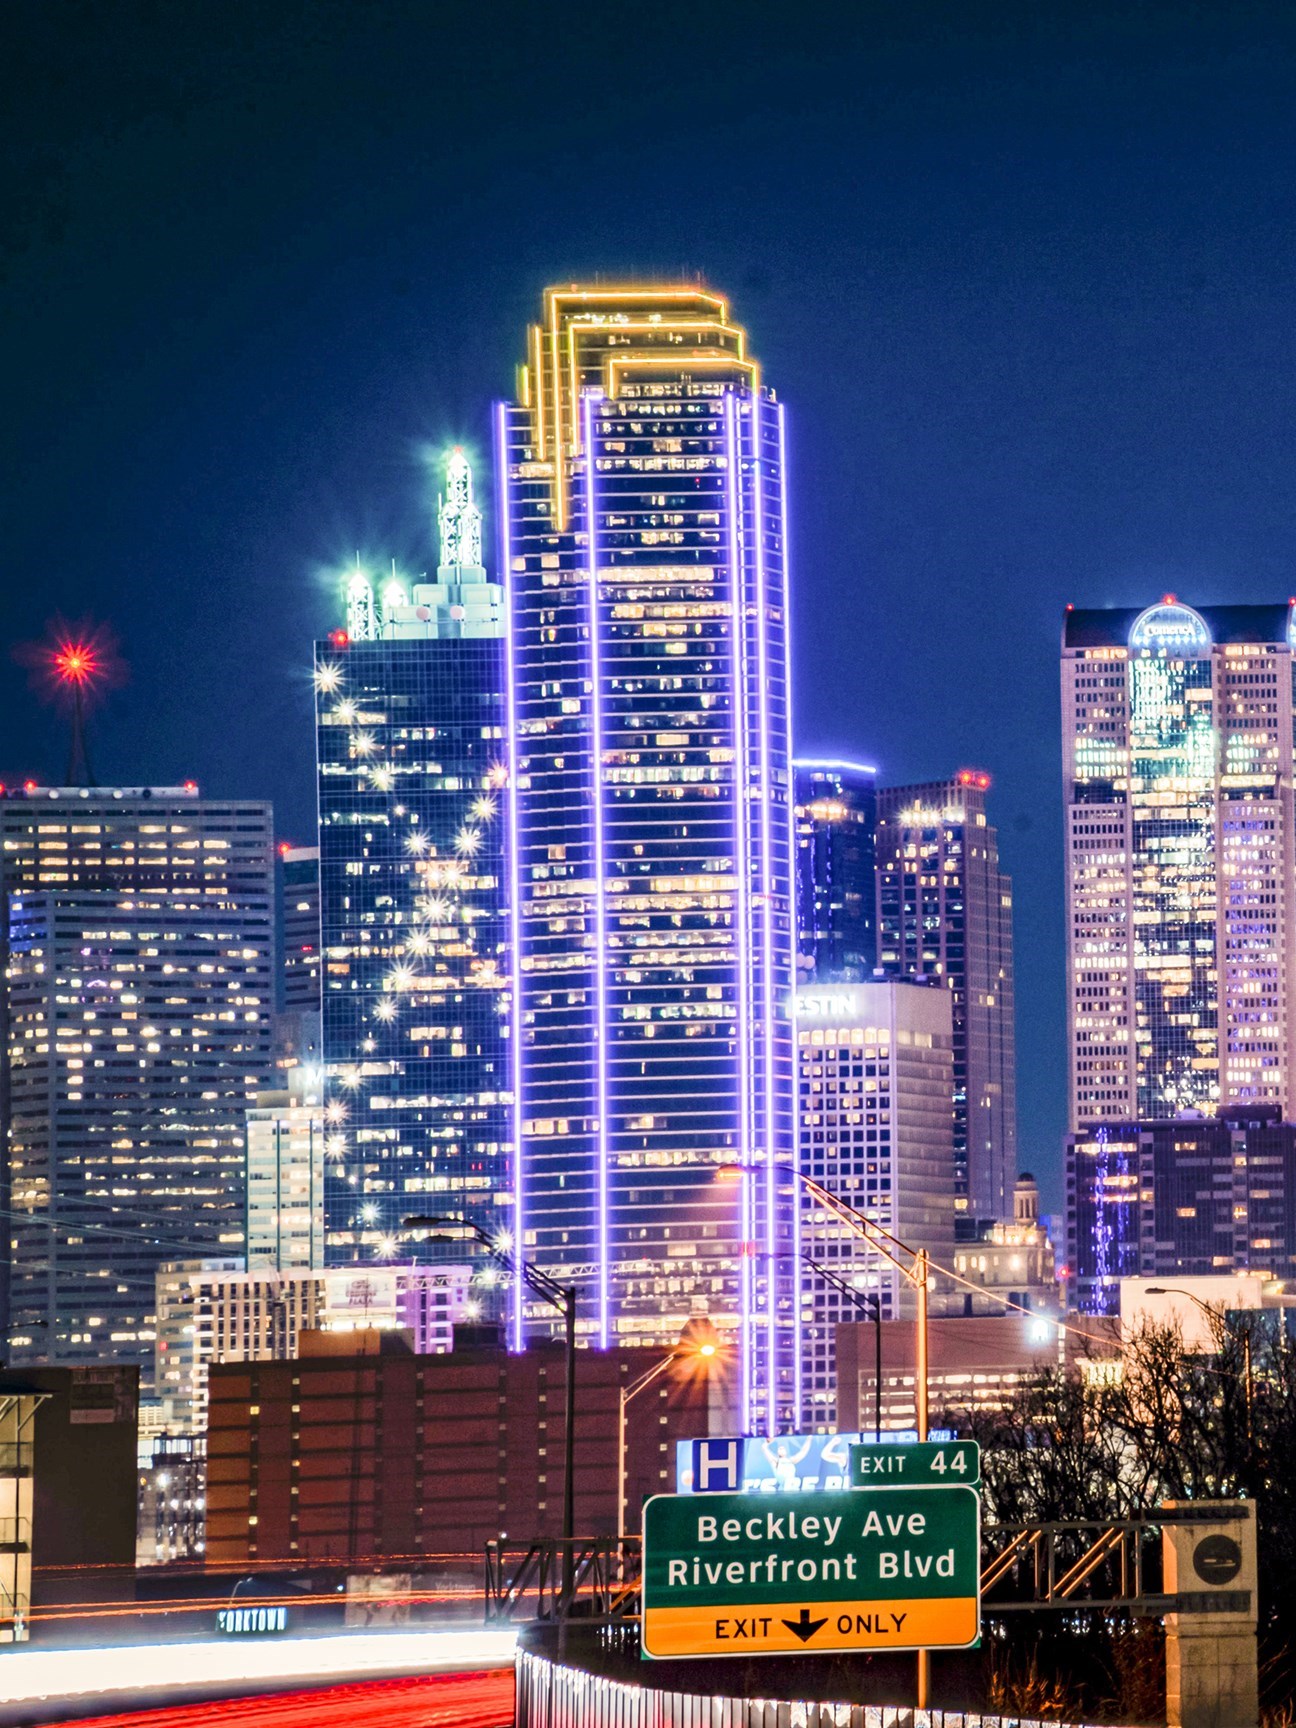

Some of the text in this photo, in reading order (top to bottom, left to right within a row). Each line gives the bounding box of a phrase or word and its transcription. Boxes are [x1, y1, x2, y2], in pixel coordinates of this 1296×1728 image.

[793, 995, 857, 1016] ESTIN
[700, 1441, 737, 1489] H
[860, 1450, 968, 1475] EXIT 44
[697, 1510, 927, 1546] Beckley Ave
[668, 1549, 956, 1586] Riverfront Blvd
[219, 1607, 287, 1632] YORKTOWN
[715, 1613, 908, 1640] EXIT ONLY
